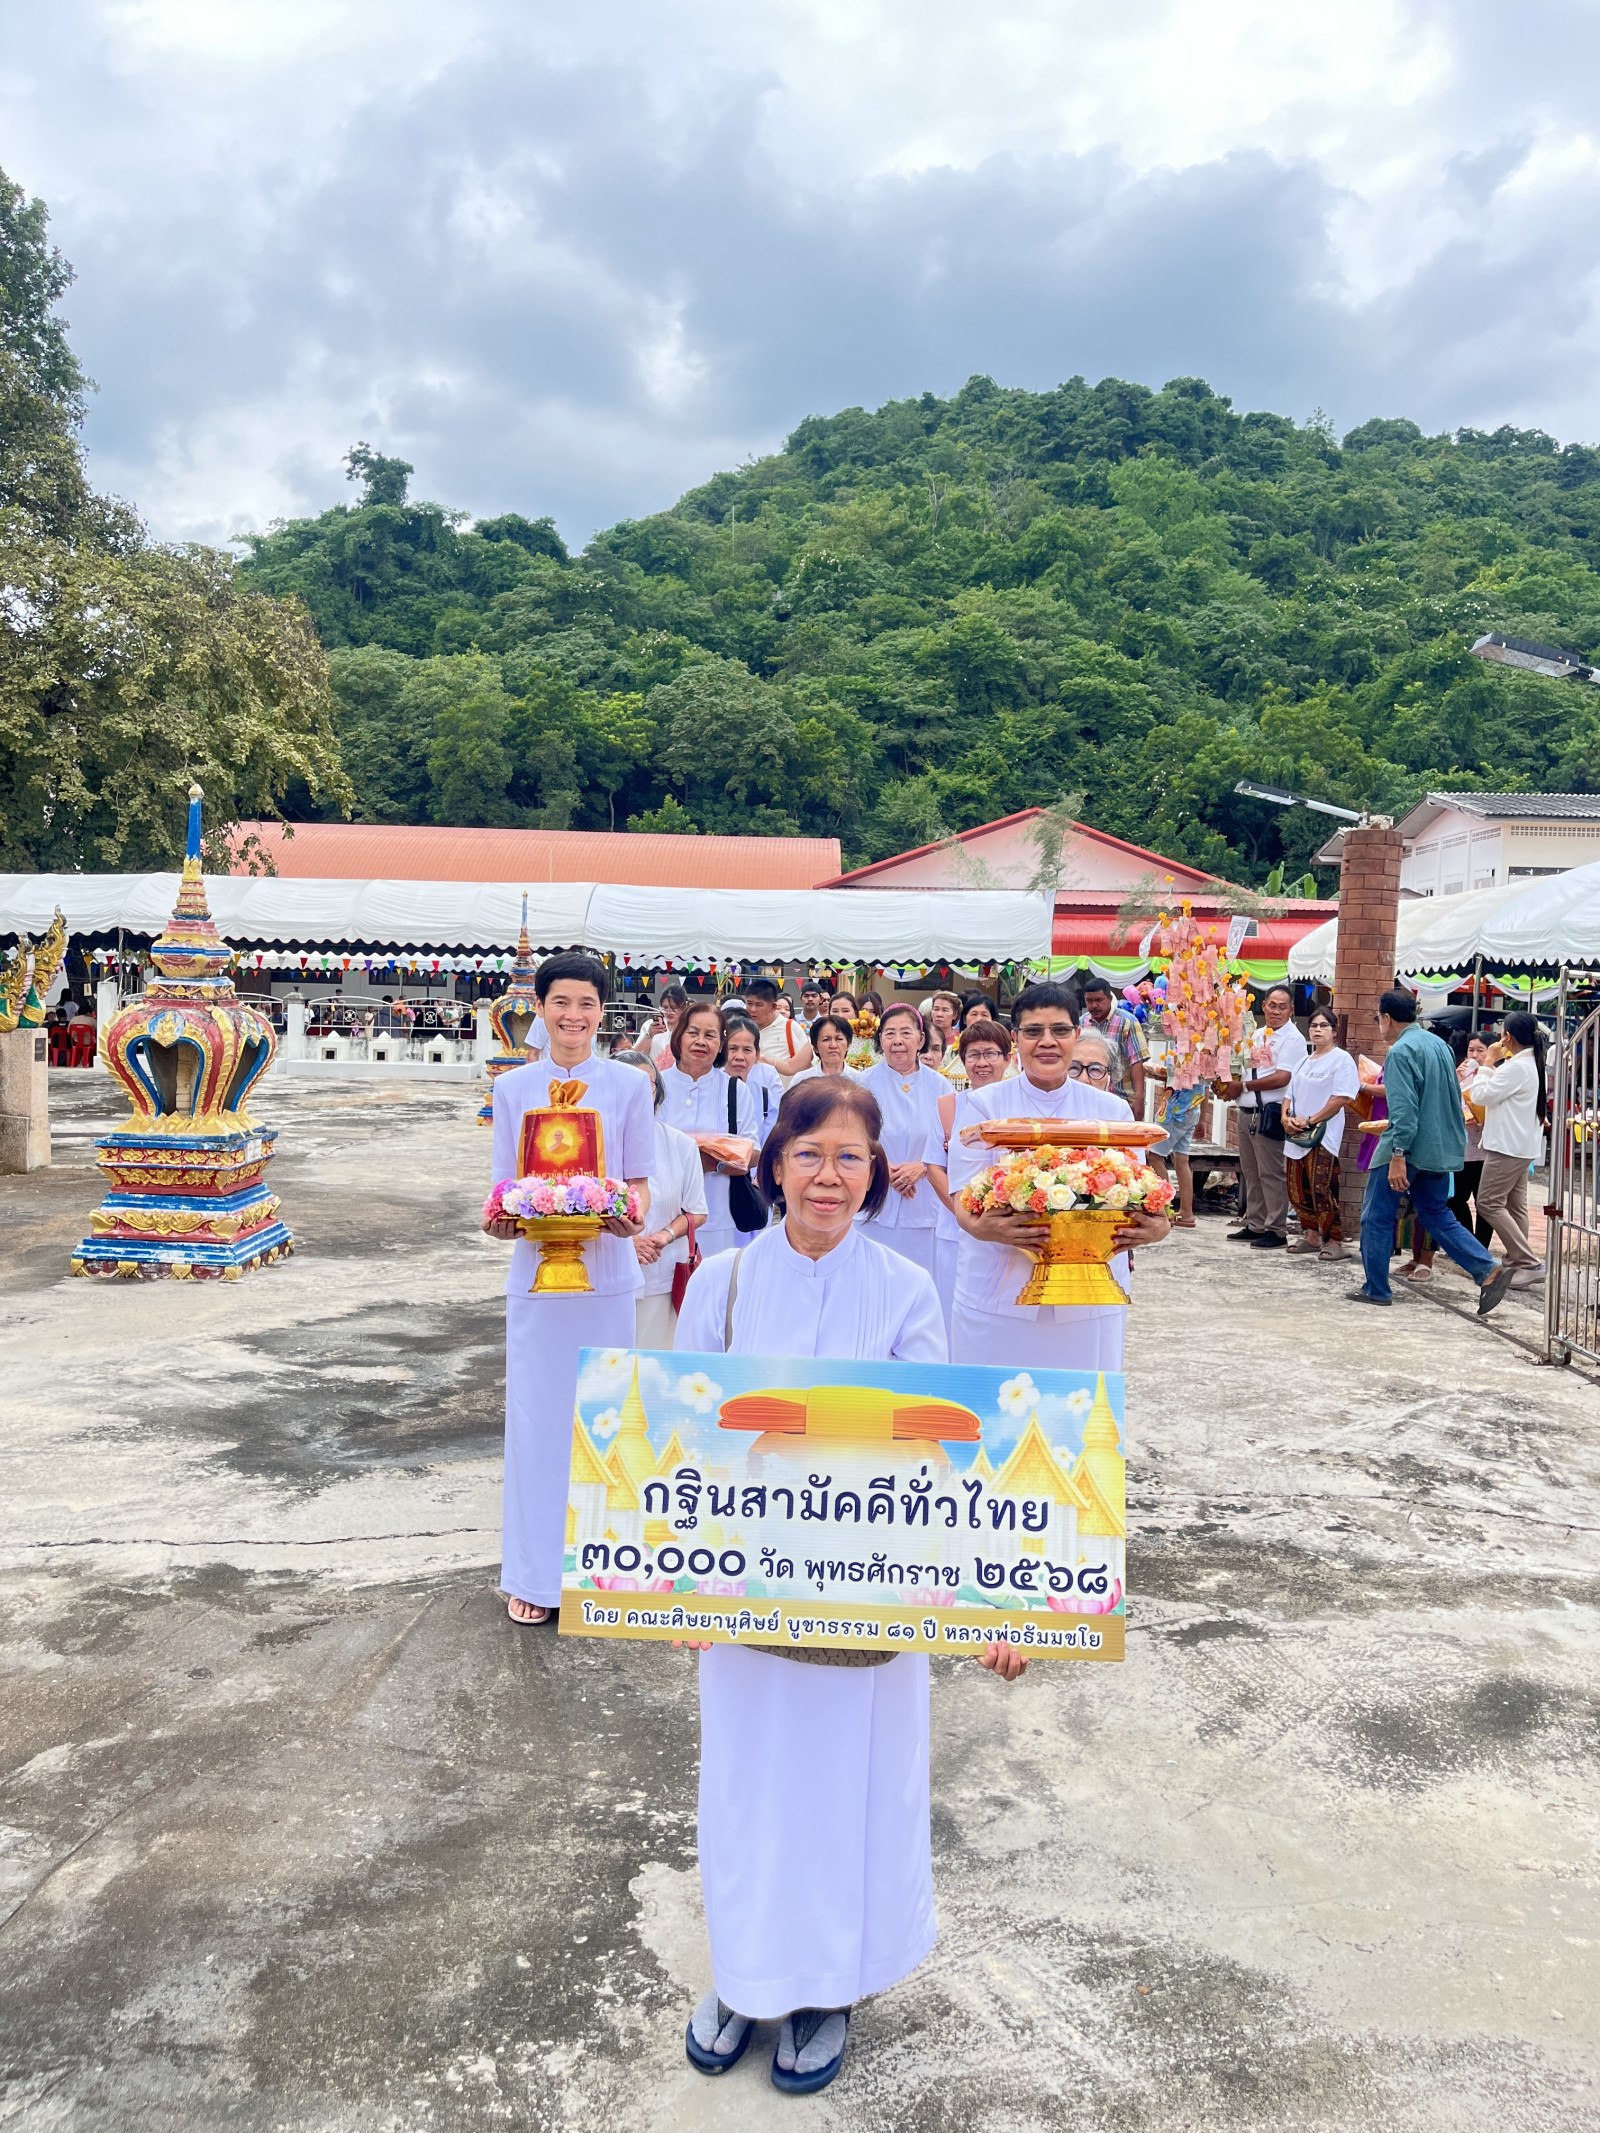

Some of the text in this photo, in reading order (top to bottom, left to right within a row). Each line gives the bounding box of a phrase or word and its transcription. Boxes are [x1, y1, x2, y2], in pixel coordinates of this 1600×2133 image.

[643, 1465, 1049, 1532] กฐินสามัคคีทั่วไทย
[581, 1543, 1109, 1595] ๓๐,๐๐๐ วัด พุทธศักราช ๒๕๖๘
[583, 1602, 1101, 1648] โดย คณะศิษยานุศิษย์ บูชาธรรม ๘๑ ปี หลวงพ่อธัมมชโย
